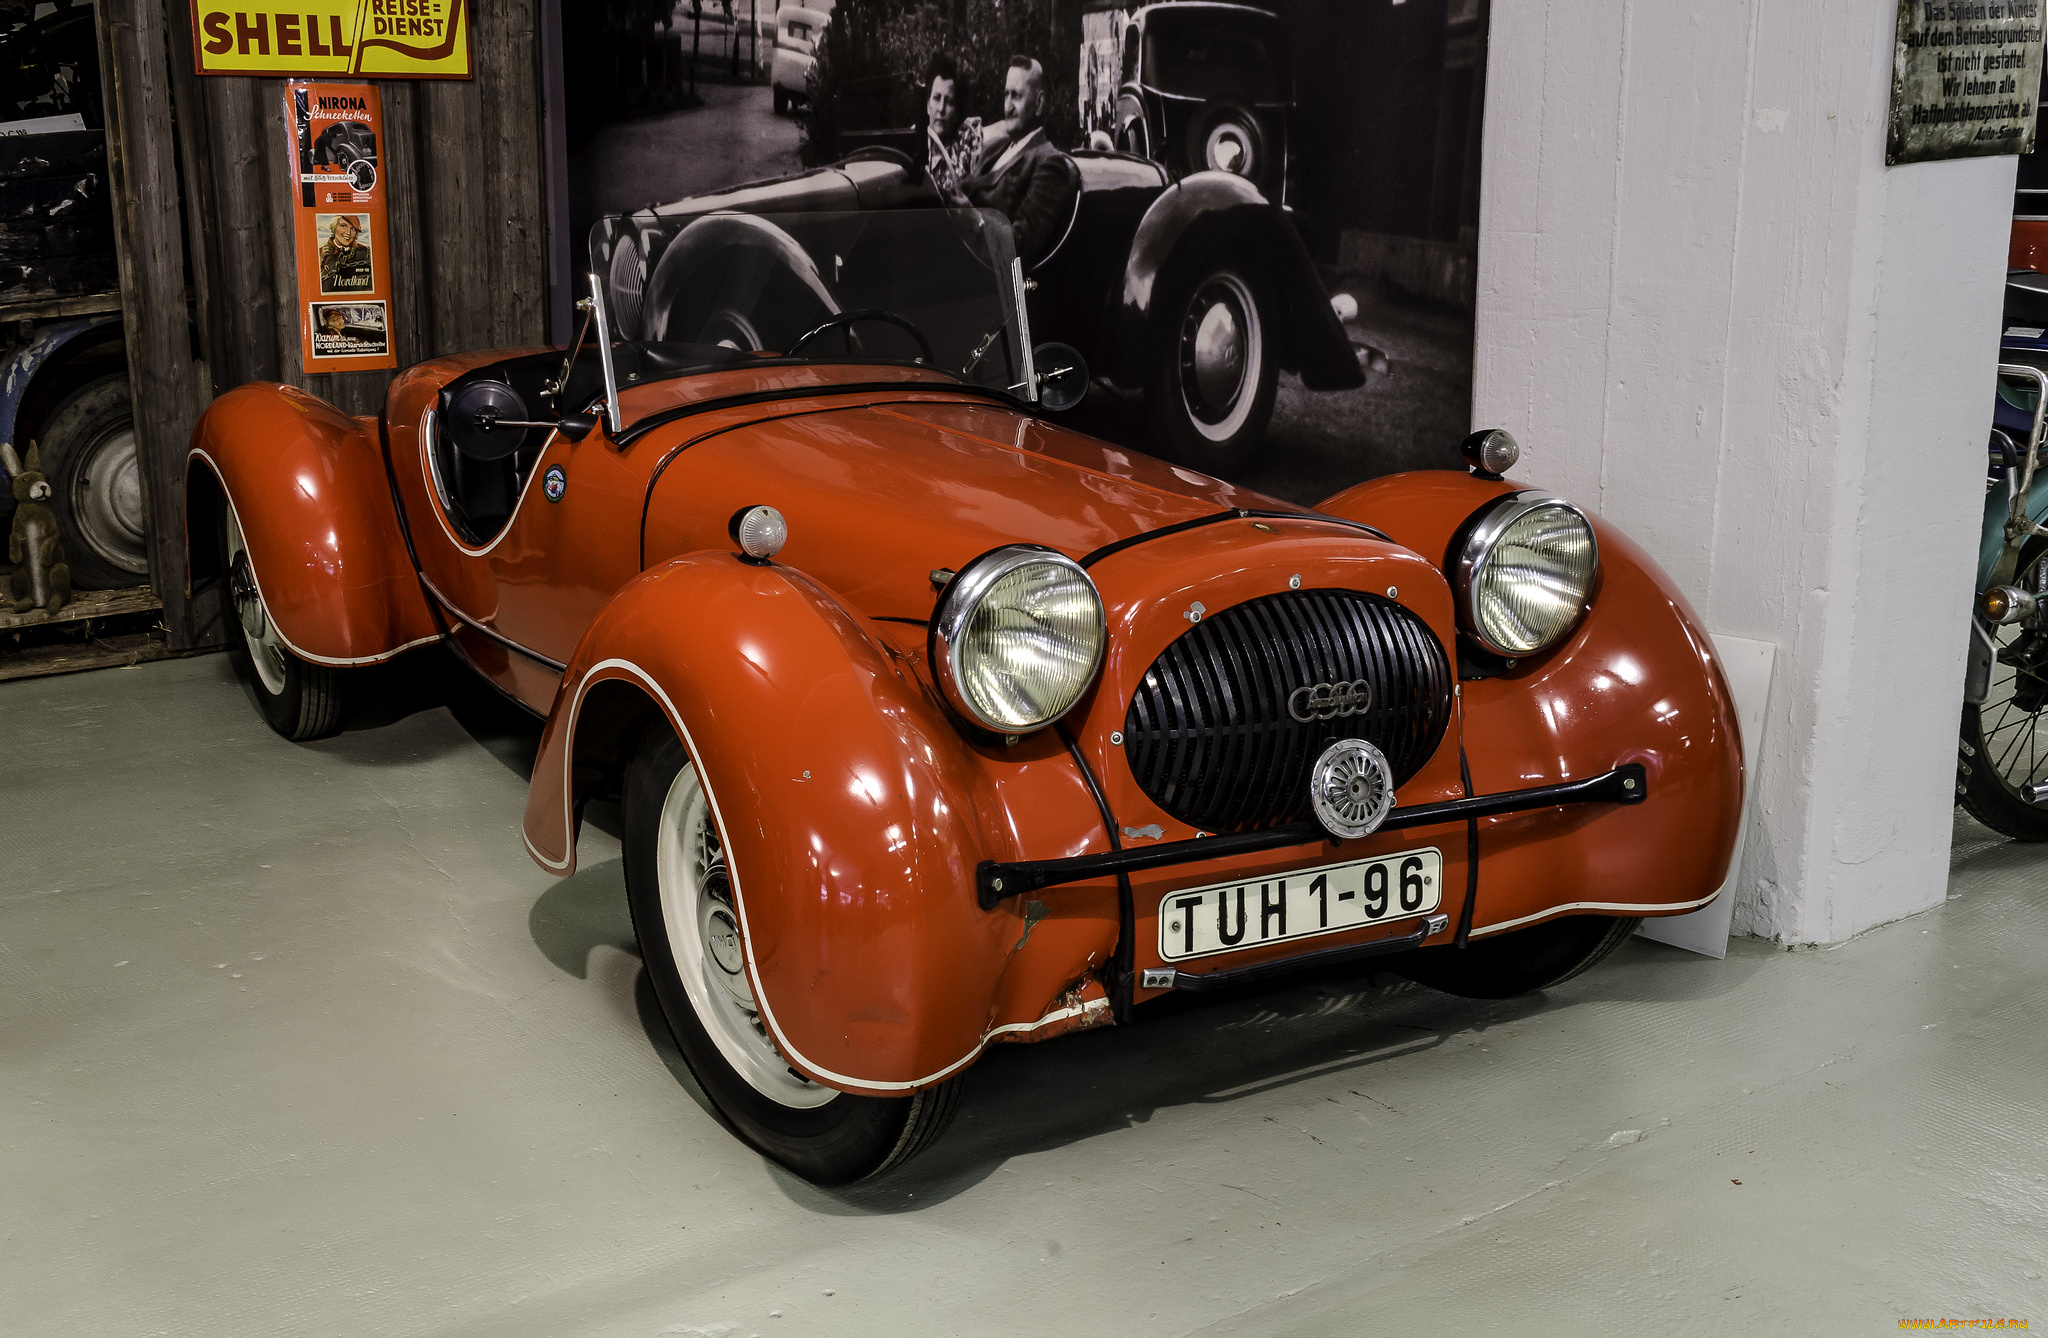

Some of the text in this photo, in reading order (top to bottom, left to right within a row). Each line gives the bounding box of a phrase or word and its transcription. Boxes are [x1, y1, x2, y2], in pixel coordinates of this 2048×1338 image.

[1925, 0, 2038, 23] Das Spielen der Kinder
[203, 11, 352, 57] SHELL
[374, 17, 443, 36] DIENST
[1907, 24, 2042, 48] auf dem Betriebsgrundstück
[1937, 49, 2026, 74] ist nicht gestattet.
[1942, 73, 2016, 97] Wir lehnen alle
[303, 104, 373, 121] Schneeketten
[319, 96, 367, 110] NIRONA
[1911, 98, 2019, 127] Haftpflichtansprüche
[333, 274, 370, 286] Nordland
[315, 332, 340, 342] Warum
[1175, 856, 1424, 953] TUH 1-96
